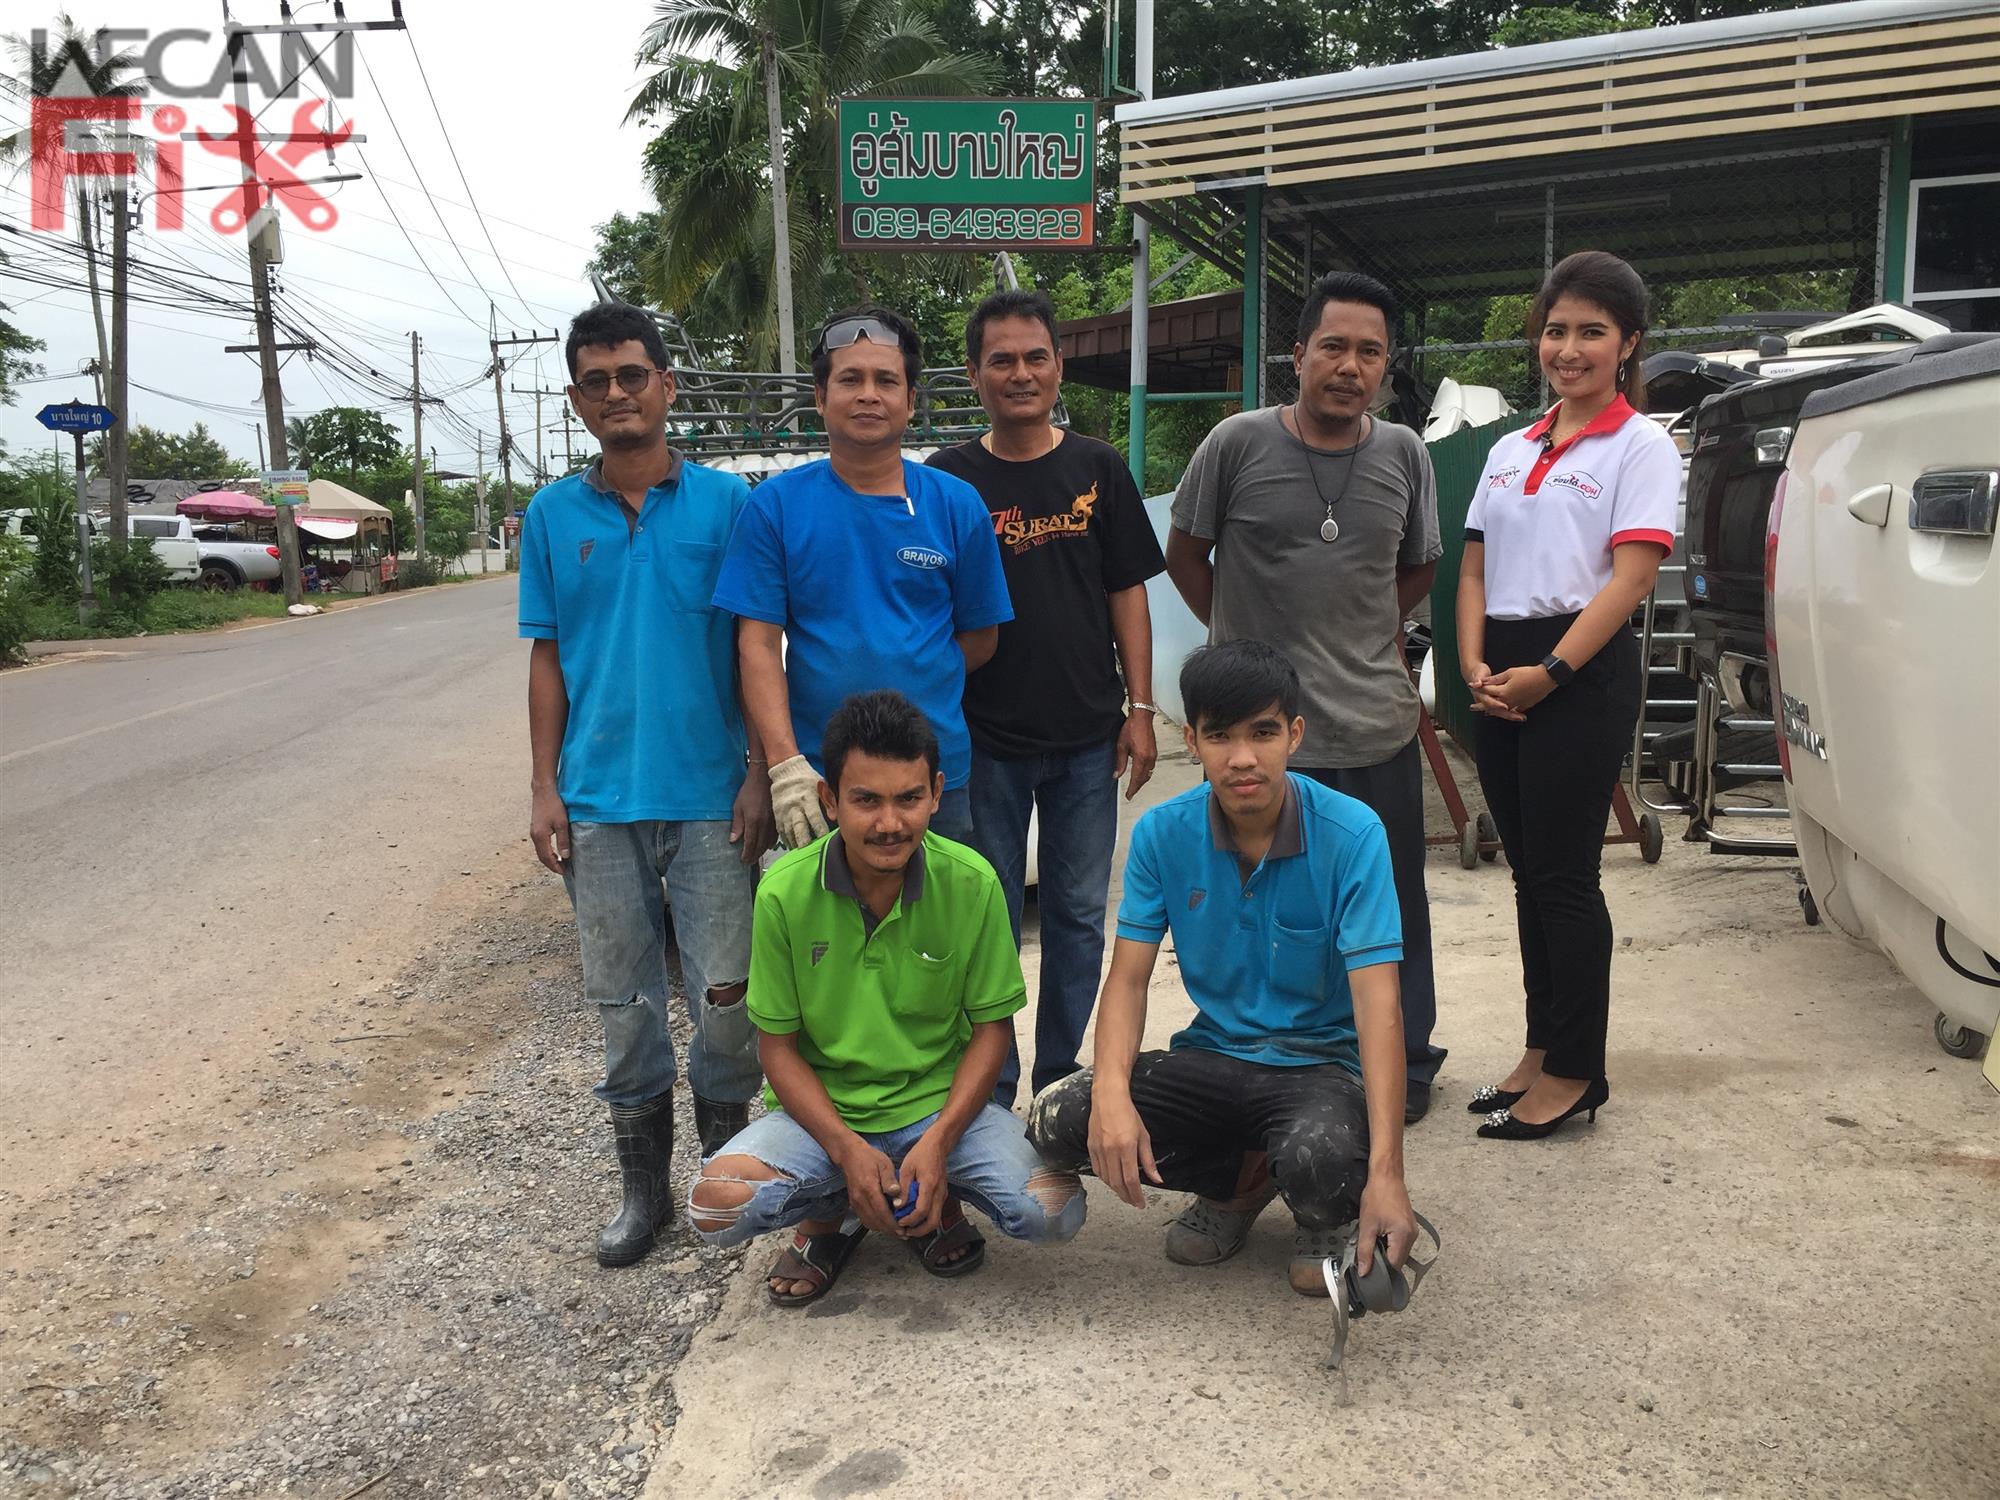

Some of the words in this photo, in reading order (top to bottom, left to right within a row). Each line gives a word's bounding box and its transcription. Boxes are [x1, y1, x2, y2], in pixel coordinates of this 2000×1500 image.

[851, 109, 1086, 197] อู่ส้มบางใหญ่
[852, 207, 1083, 240] 089-6493928
[1770, 367, 1795, 375] ISUZU
[51, 408, 89, 423] บางใหญ่
[92, 412, 102, 425] 10
[1004, 514, 1075, 545] SURAT
[903, 550, 943, 567] BRAVOS
